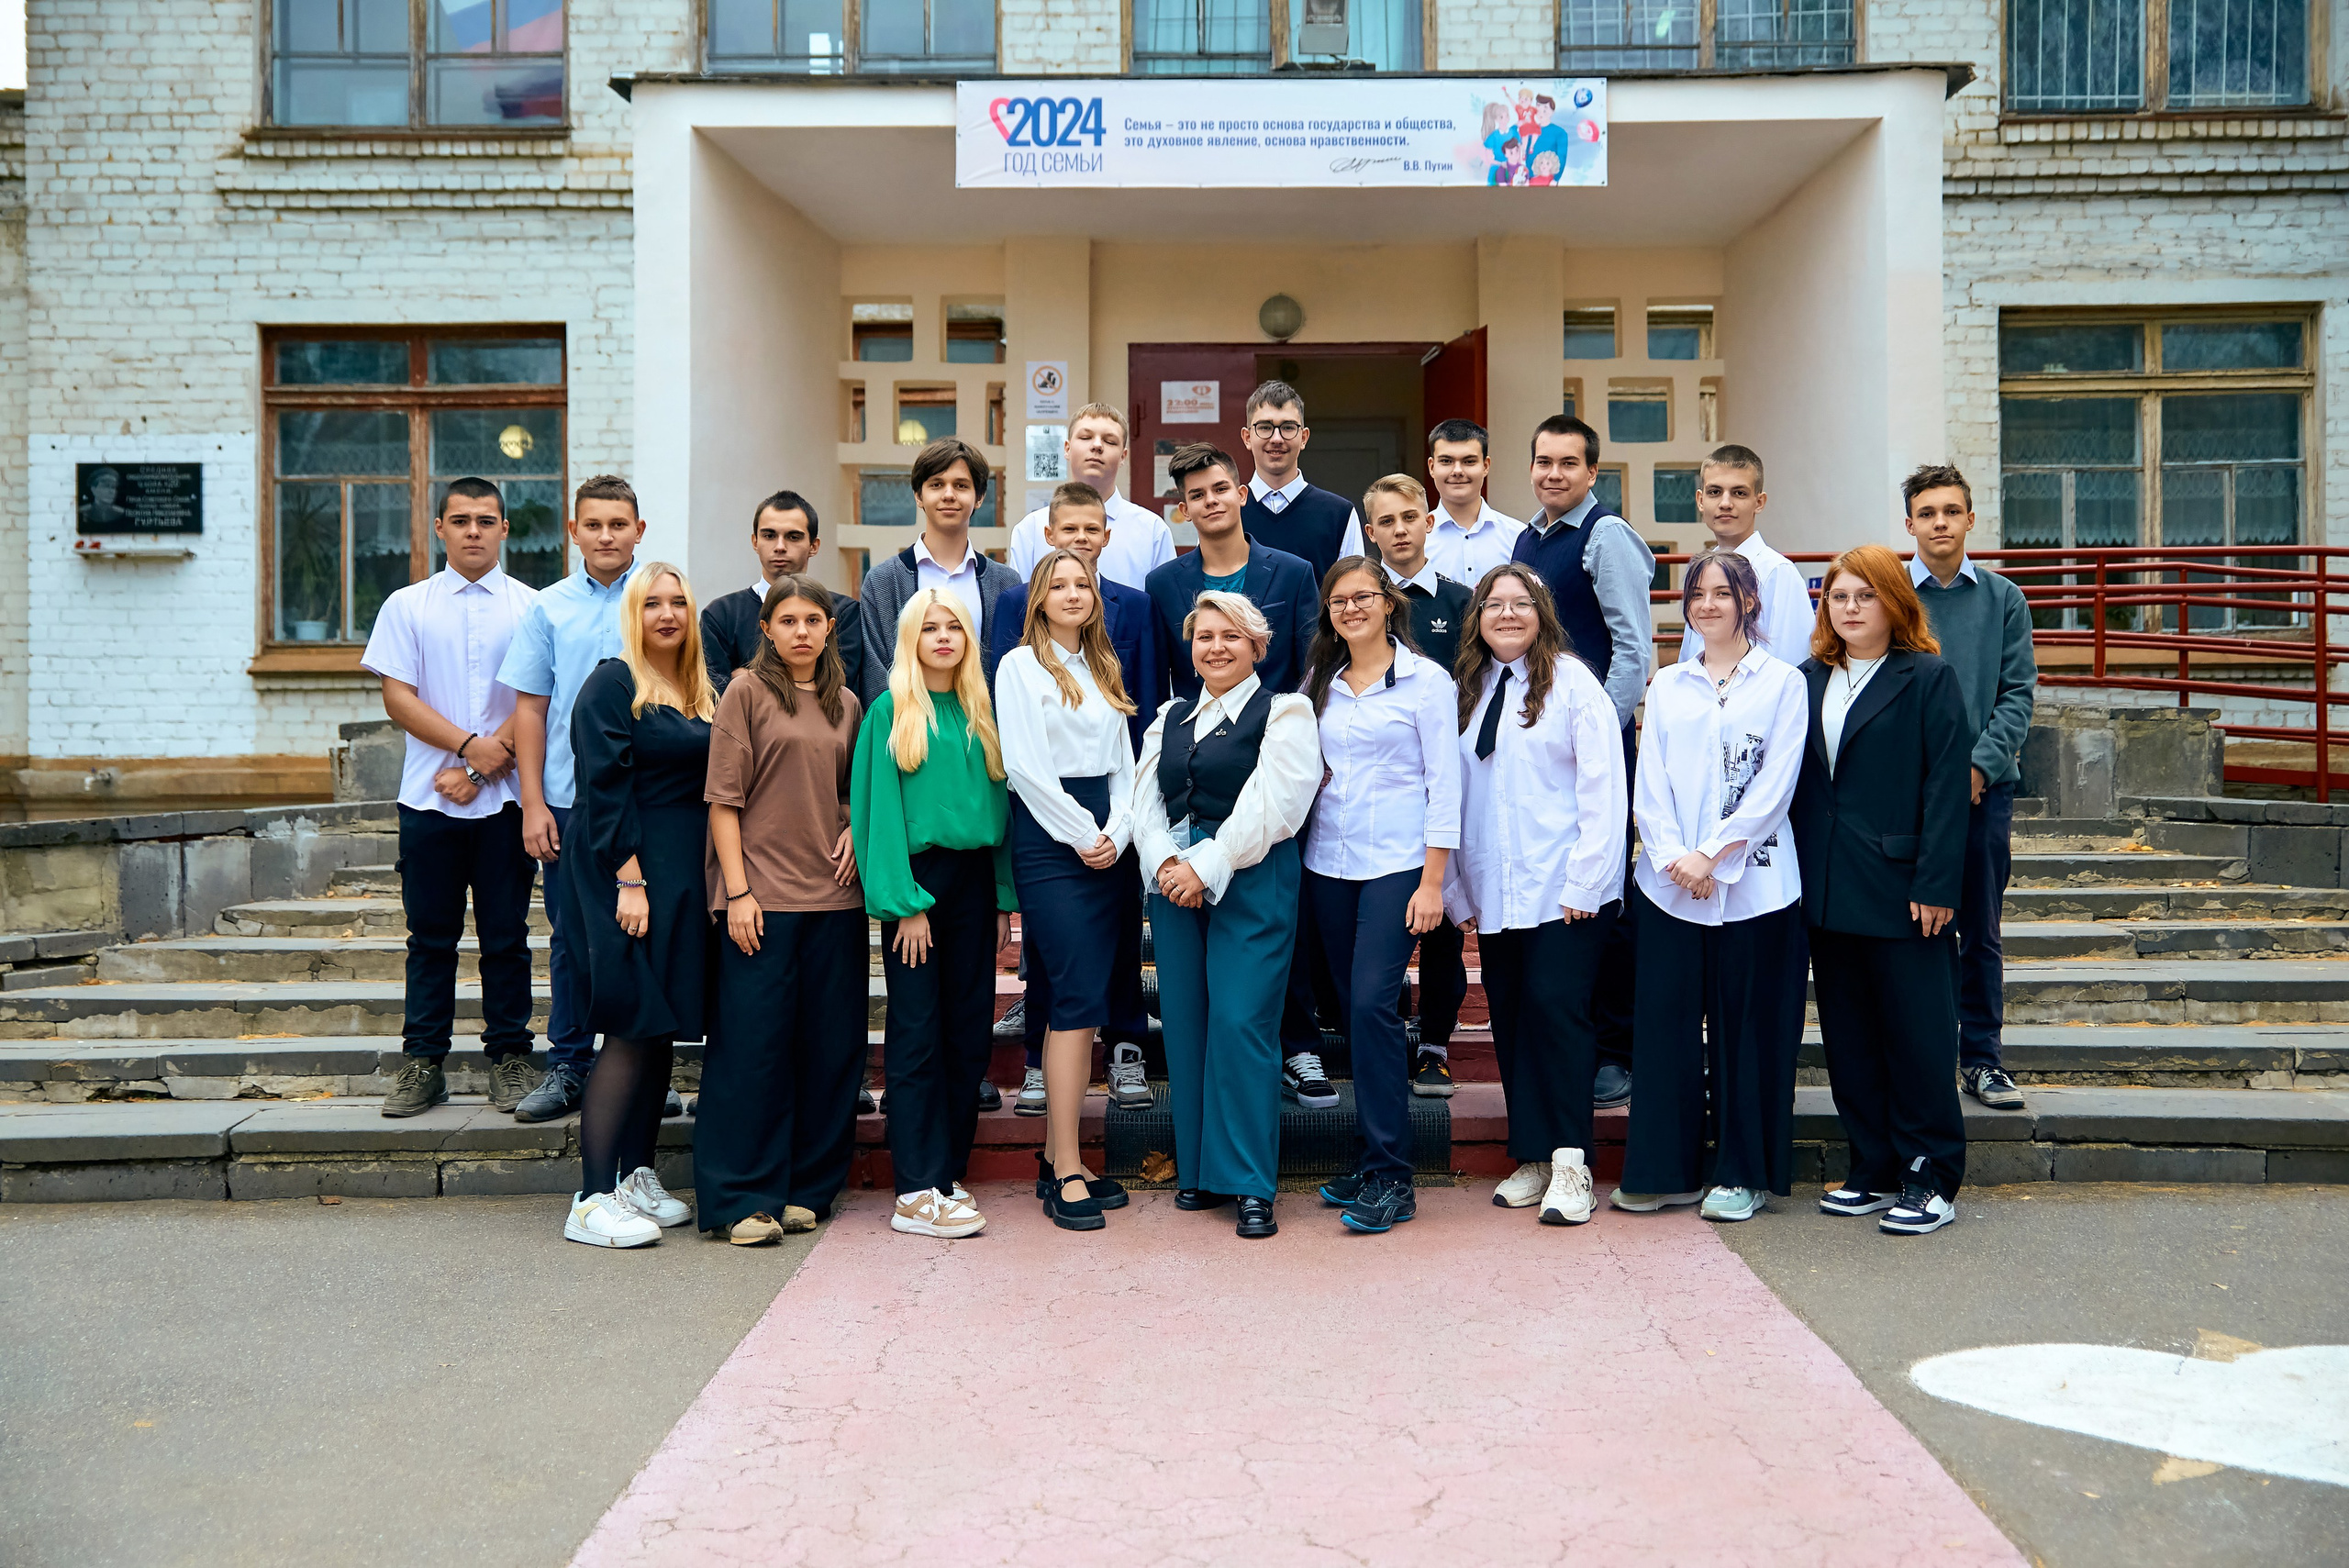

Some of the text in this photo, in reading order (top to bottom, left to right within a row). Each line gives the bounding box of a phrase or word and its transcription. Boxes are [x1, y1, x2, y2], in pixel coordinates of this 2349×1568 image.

[1007, 96, 1107, 147] 2024
[1124, 117, 1162, 131] Семья
[1177, 120, 1197, 131] это
[1200, 120, 1215, 131] не
[1218, 120, 1260, 133] просто
[1262, 120, 1305, 131] основа
[1308, 120, 1381, 134] государства
[1384, 120, 1392, 131] и
[1395, 117, 1456, 132] общества,
[1124, 135, 1410, 150] это духовное явление, основа нравственности.
[1403, 160, 1421, 172] В.В.
[1424, 160, 1453, 173] Путин
